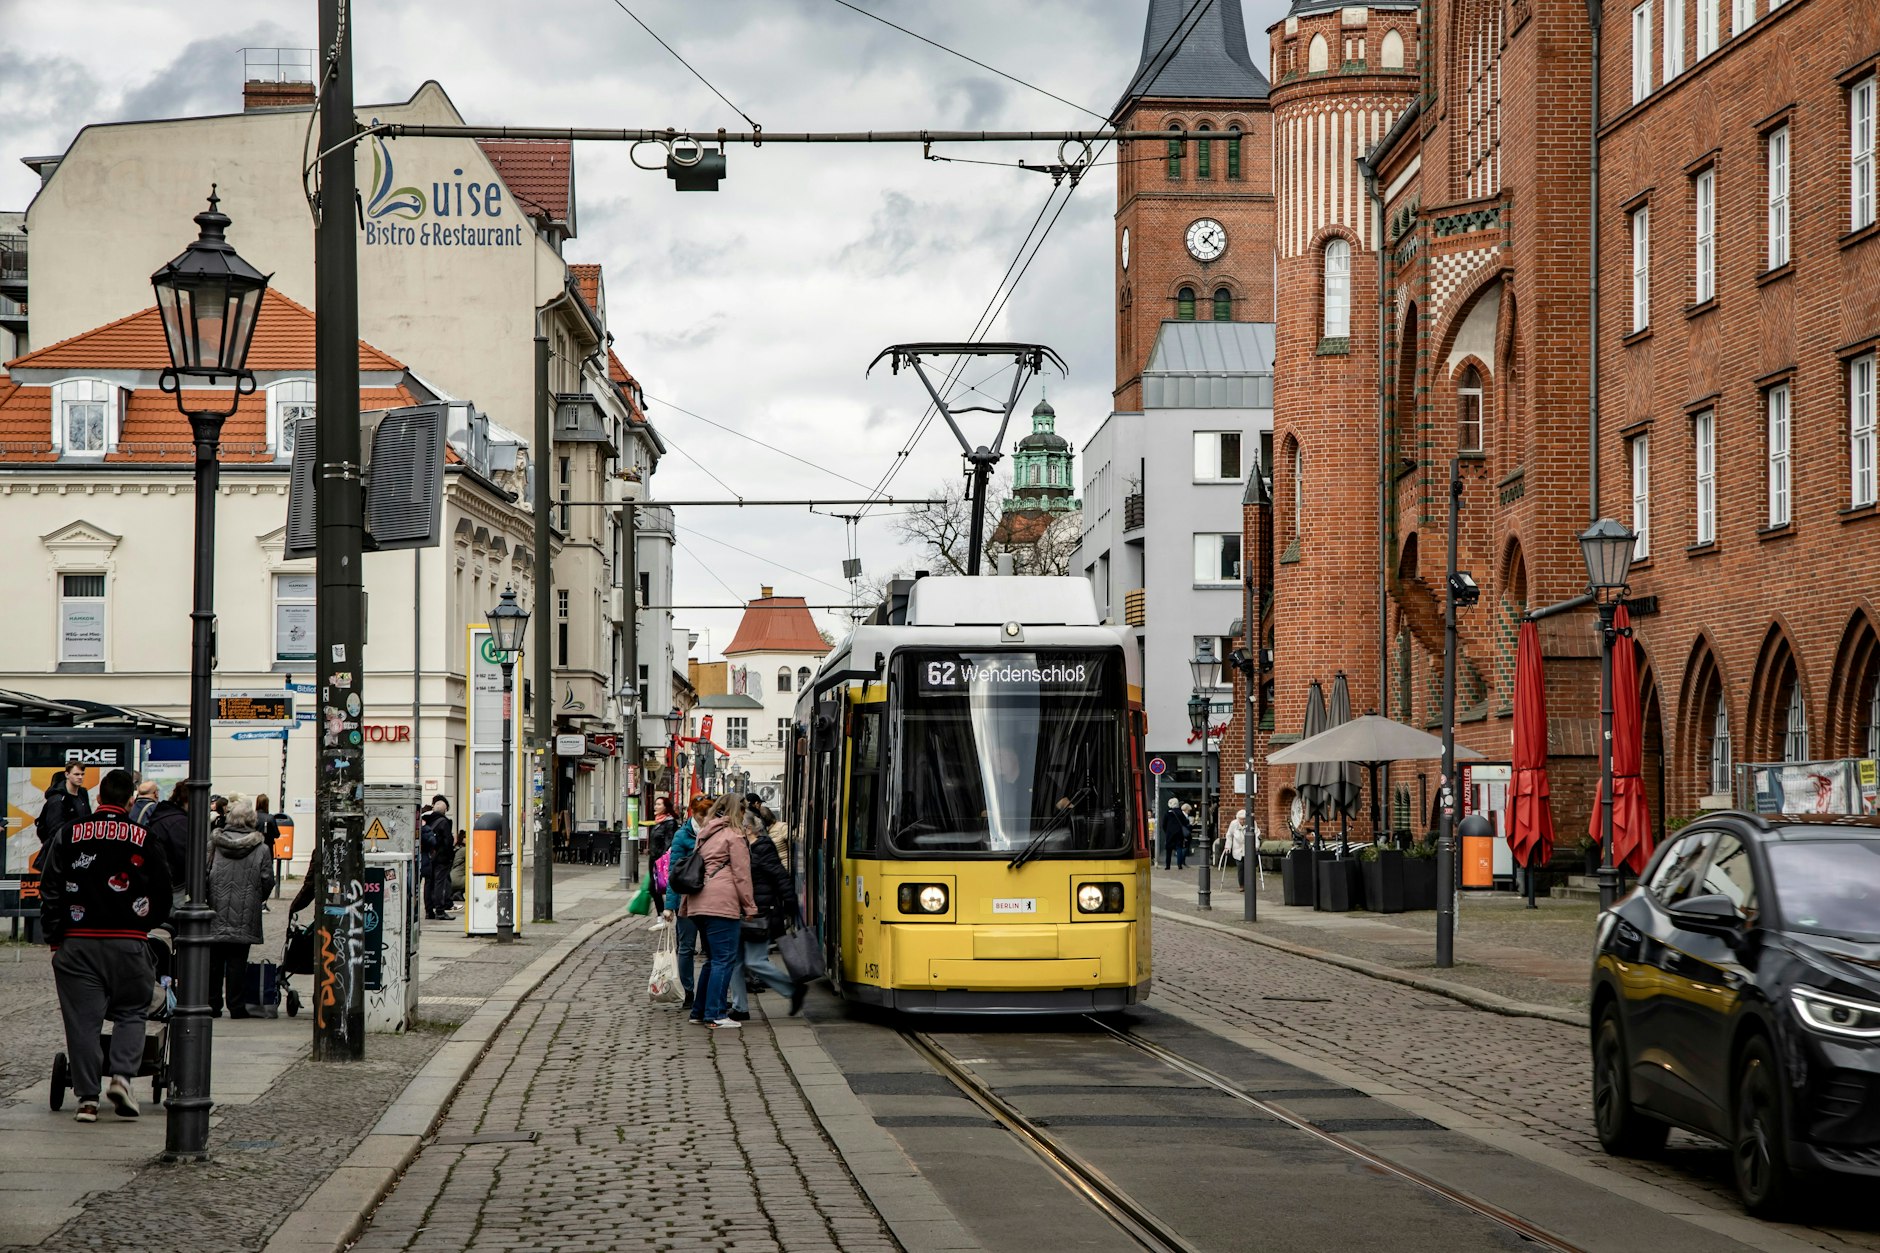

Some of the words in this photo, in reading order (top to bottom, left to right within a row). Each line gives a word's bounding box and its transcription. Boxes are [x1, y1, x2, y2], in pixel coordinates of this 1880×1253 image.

[366, 220, 416, 246] Bistro
[927, 661, 956, 685] 62
[961, 664, 1086, 683] Wendenschloß
[363, 725, 410, 742] TOUR
[65, 748, 117, 762] AXE
[72, 821, 147, 847] DBUBDW
